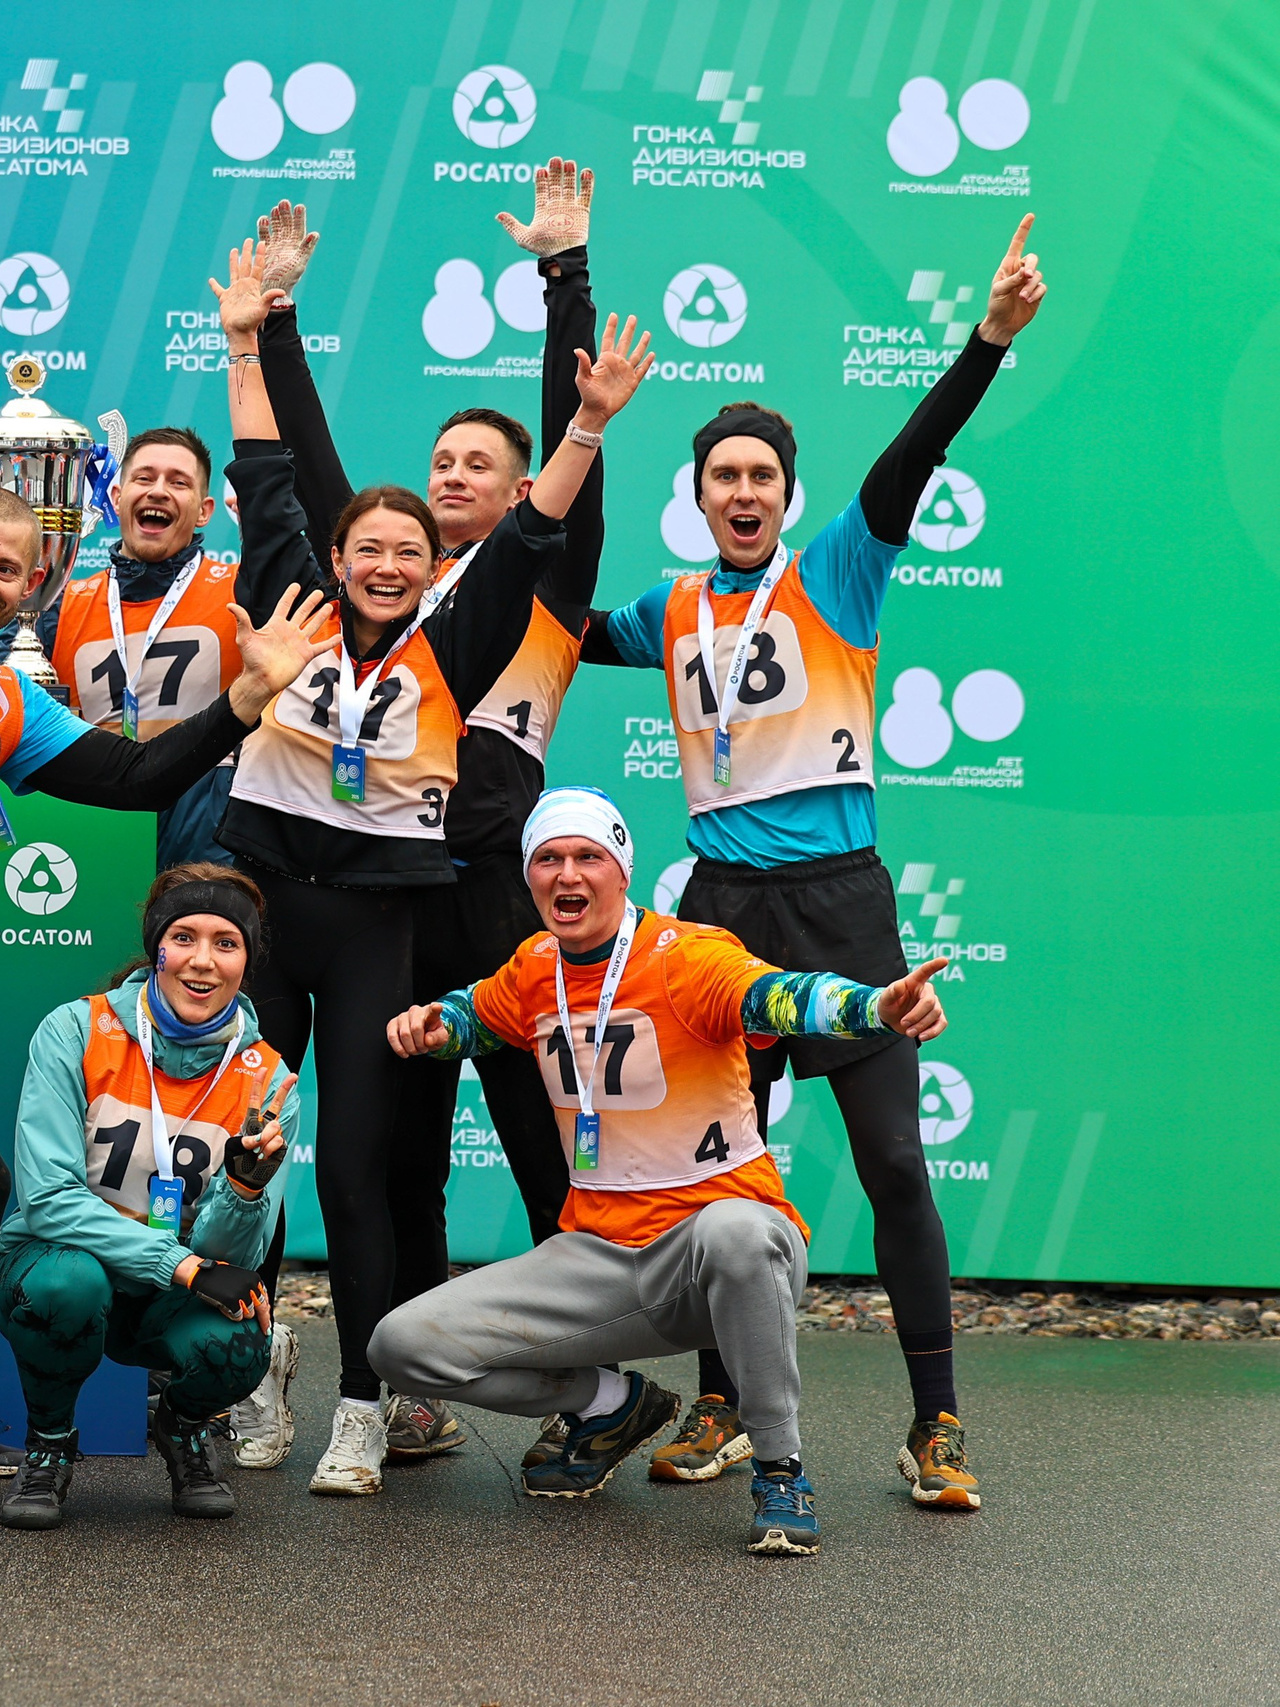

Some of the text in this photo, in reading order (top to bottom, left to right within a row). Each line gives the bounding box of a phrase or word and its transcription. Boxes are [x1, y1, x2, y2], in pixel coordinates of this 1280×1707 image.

[632, 125, 716, 145] ГОНКА
[283, 157, 356, 171] АТОМНОЙ
[328, 148, 355, 161] ЛЕТ
[632, 147, 807, 169] ДИВИЗИОНОВ
[212, 166, 356, 180] ПРОМЫШЛЕННОСТИ
[434, 162, 538, 184] РОСАТО
[632, 168, 765, 188] РОСАТОМА
[958, 173, 1030, 187] АТОМНОЙ
[1003, 165, 1029, 178] ЛЕТ
[888, 181, 1031, 197] ПРОМЫШЛЕННОСТИ
[164, 308, 222, 331] ГОН
[164, 331, 342, 356] ДИВОВ
[843, 324, 926, 345] ГОНКА
[164, 352, 229, 374] РОСА
[495, 354, 544, 368] АТОМН
[841, 348, 1018, 370] ДИВИЗИВ
[423, 364, 544, 378] ПРОМЫШЛЕННОС
[646, 361, 765, 383] РОСАТОМ
[843, 370, 945, 389] РОСАТО
[734, 644, 747, 676] РОСАТОМ
[91, 640, 200, 712] 17
[685, 631, 786, 715] 18
[507, 700, 532, 739] 1
[624, 717, 674, 736] ГОН
[831, 728, 860, 772] 2
[953, 765, 1023, 779] АТОМНОЙ
[996, 756, 1023, 769] ЛЕТ
[880, 772, 1024, 788] ПРОМЫШЛЕННОСТИ
[417, 787, 444, 828] 3
[610, 946, 625, 979] РОСАТОМ
[903, 942, 1007, 962] ЗИОНОВ
[546, 1023, 636, 1096] 17
[694, 1120, 730, 1165] 4
[93, 1118, 211, 1205] 18
[925, 1159, 990, 1181] АТОМ
[408, 1404, 437, 1433] N
